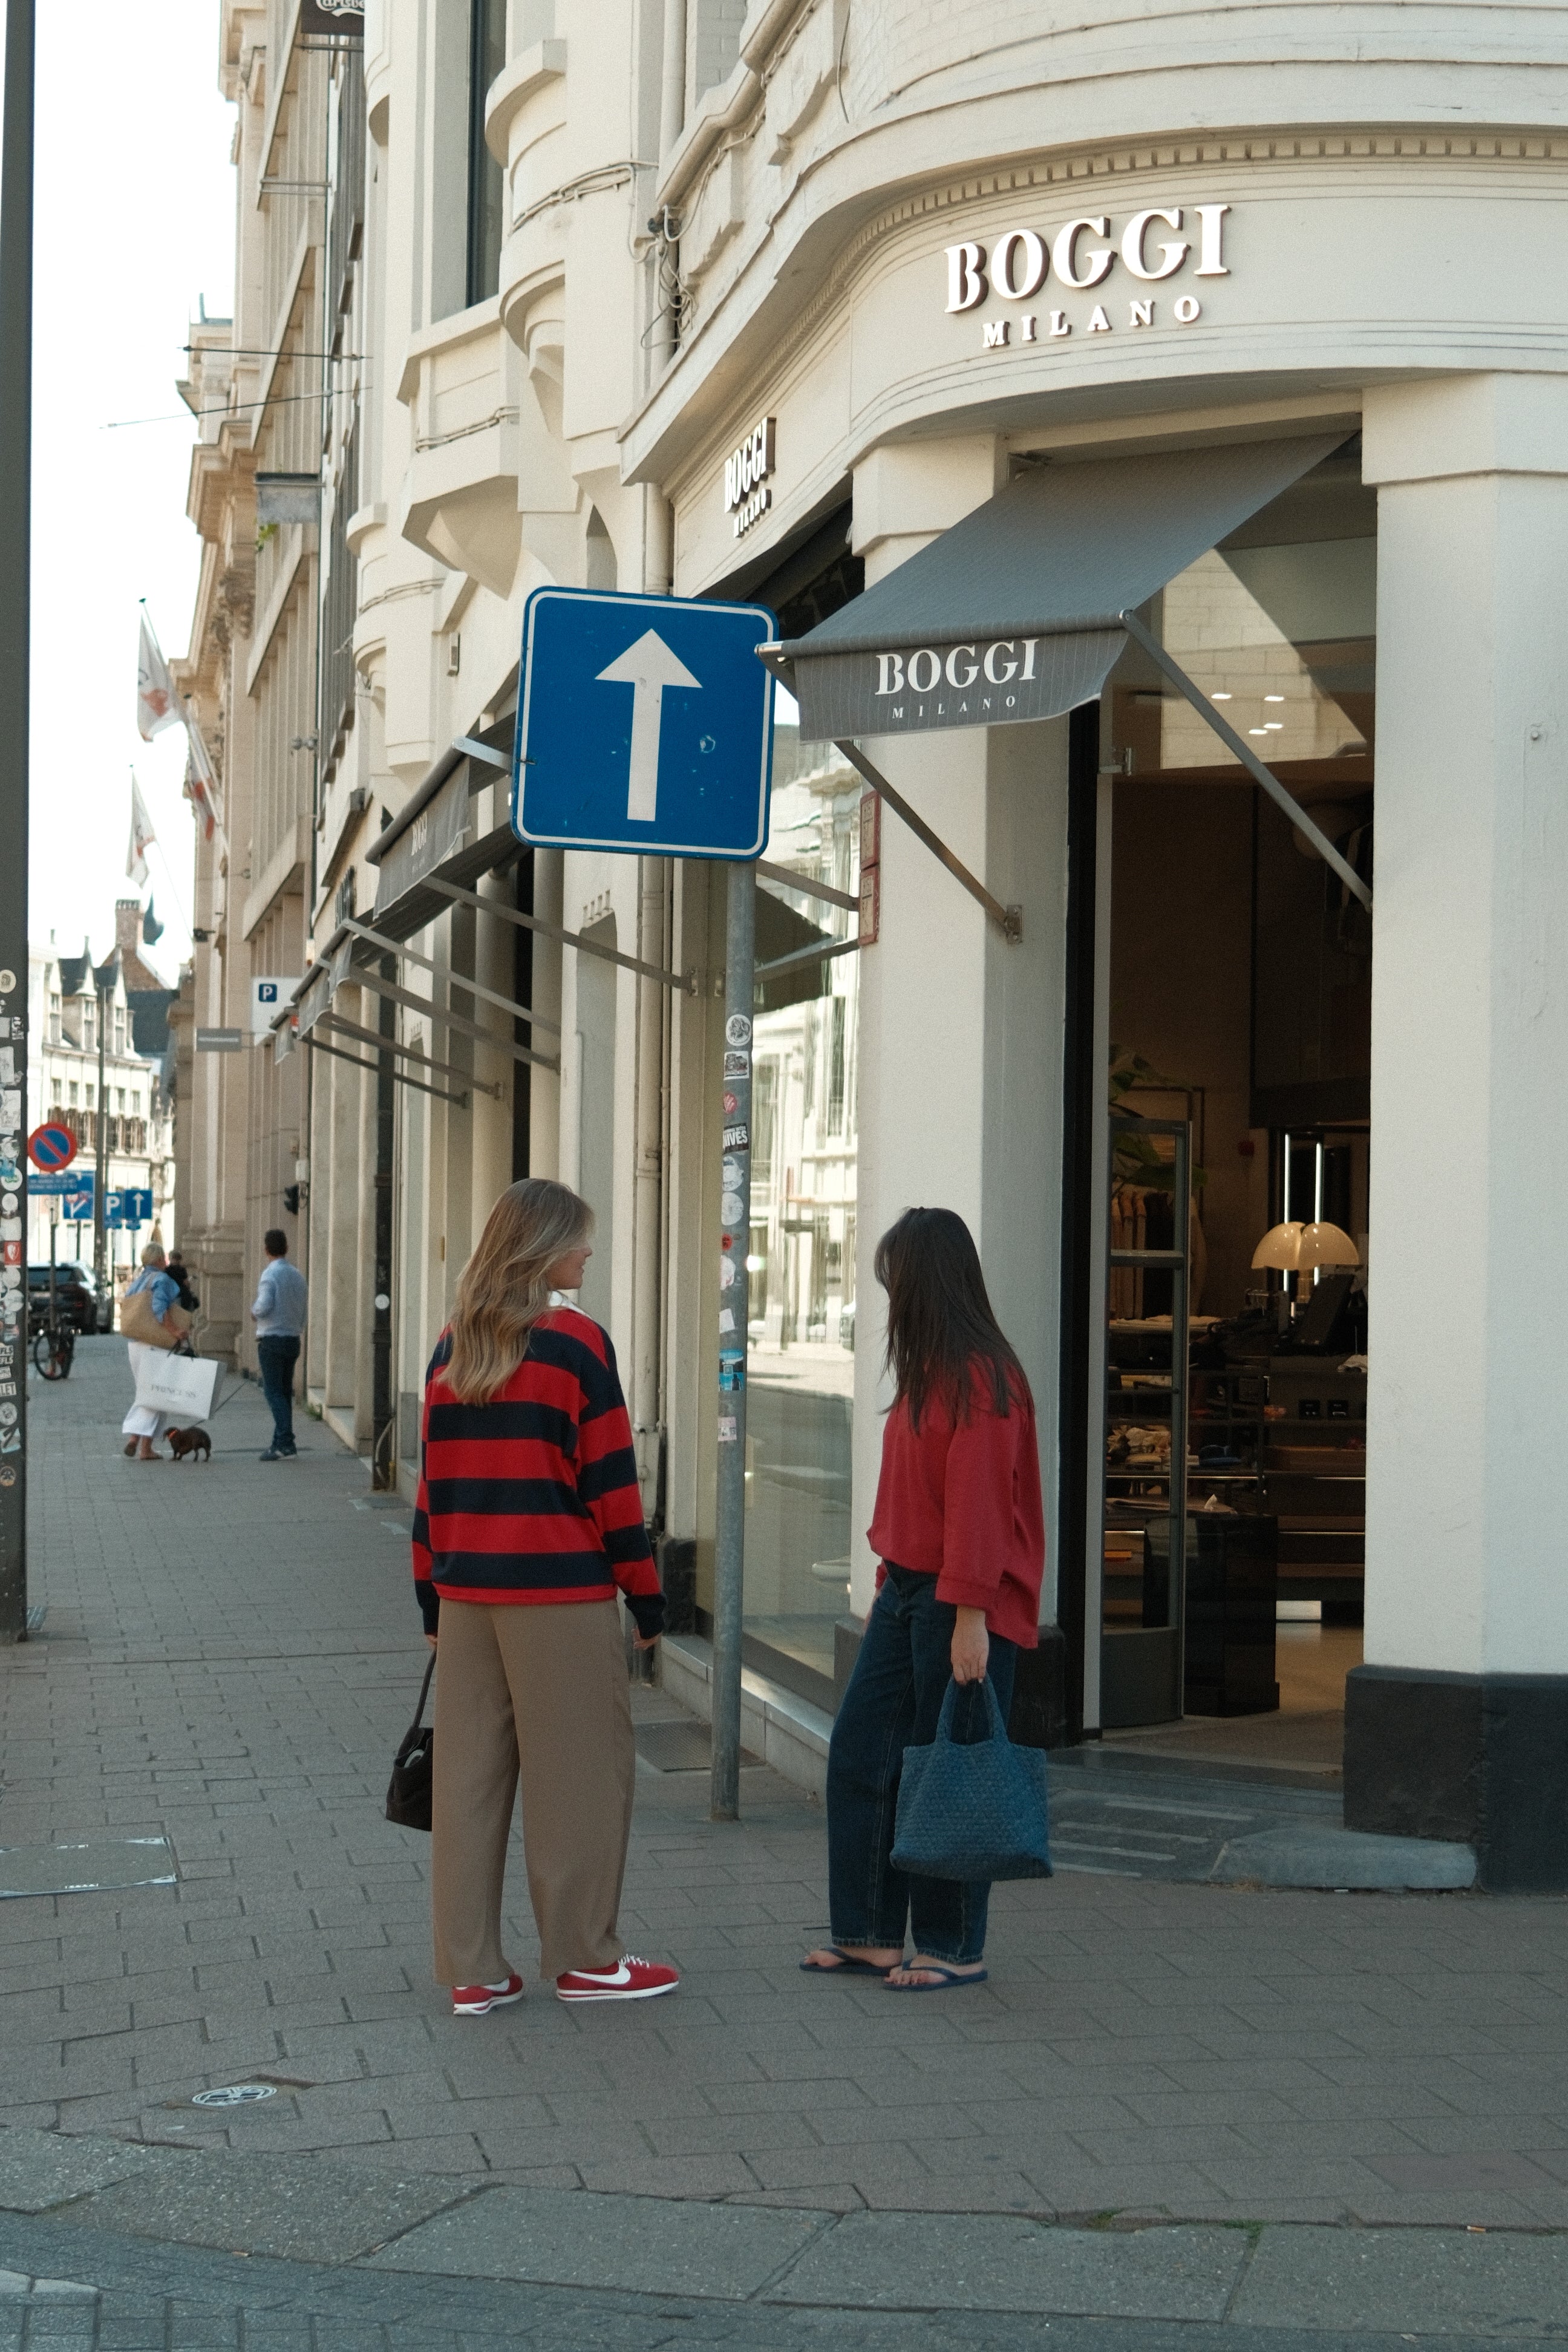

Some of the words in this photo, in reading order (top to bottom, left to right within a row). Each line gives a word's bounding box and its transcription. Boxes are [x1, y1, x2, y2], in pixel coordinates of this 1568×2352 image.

[944, 204, 1231, 313] BOGGI
[982, 295, 1201, 348] MILANO
[724, 416, 776, 514] BOGGI
[875, 638, 1039, 695] BOGGI
[892, 696, 1016, 719] MILANO
[263, 986, 273, 1000] P
[106, 1196, 120, 1215] P
